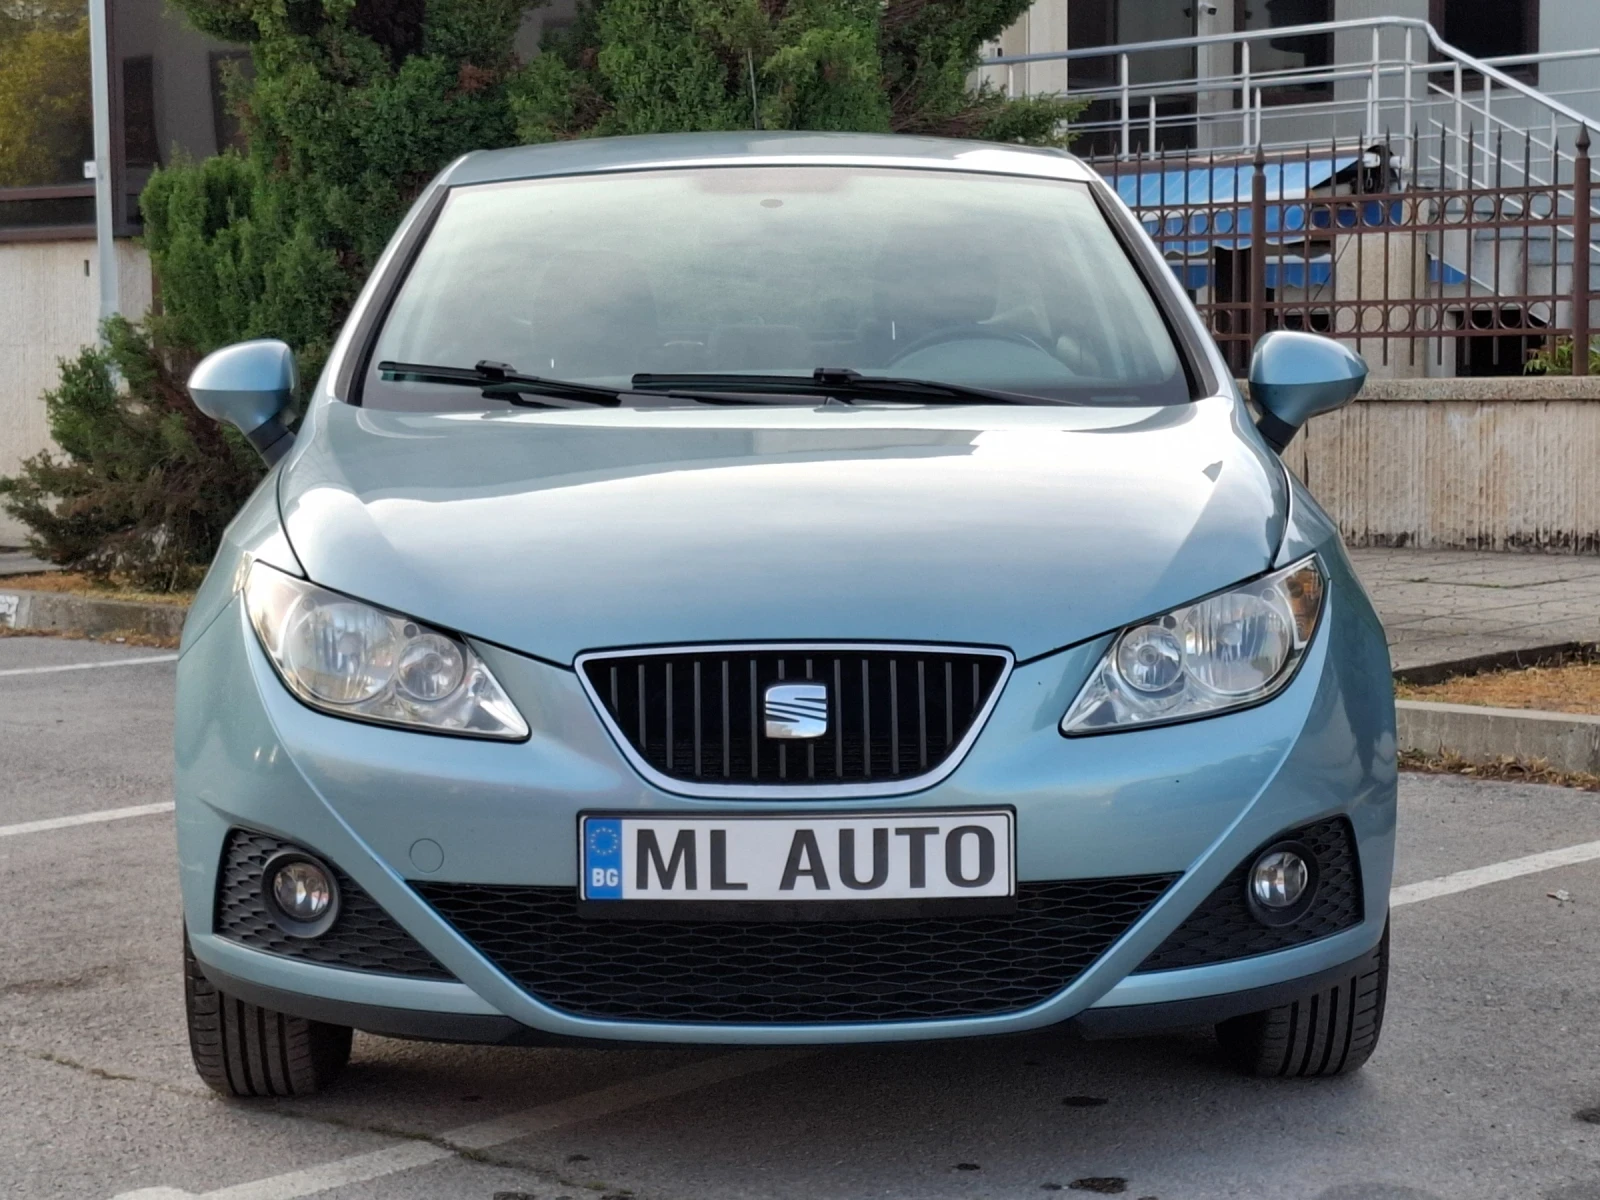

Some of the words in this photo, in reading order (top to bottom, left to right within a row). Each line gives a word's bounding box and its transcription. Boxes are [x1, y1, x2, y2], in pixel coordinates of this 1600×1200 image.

[592, 868, 619, 887] BG
[636, 829, 748, 890] ML
[779, 825, 995, 890] AUTO
